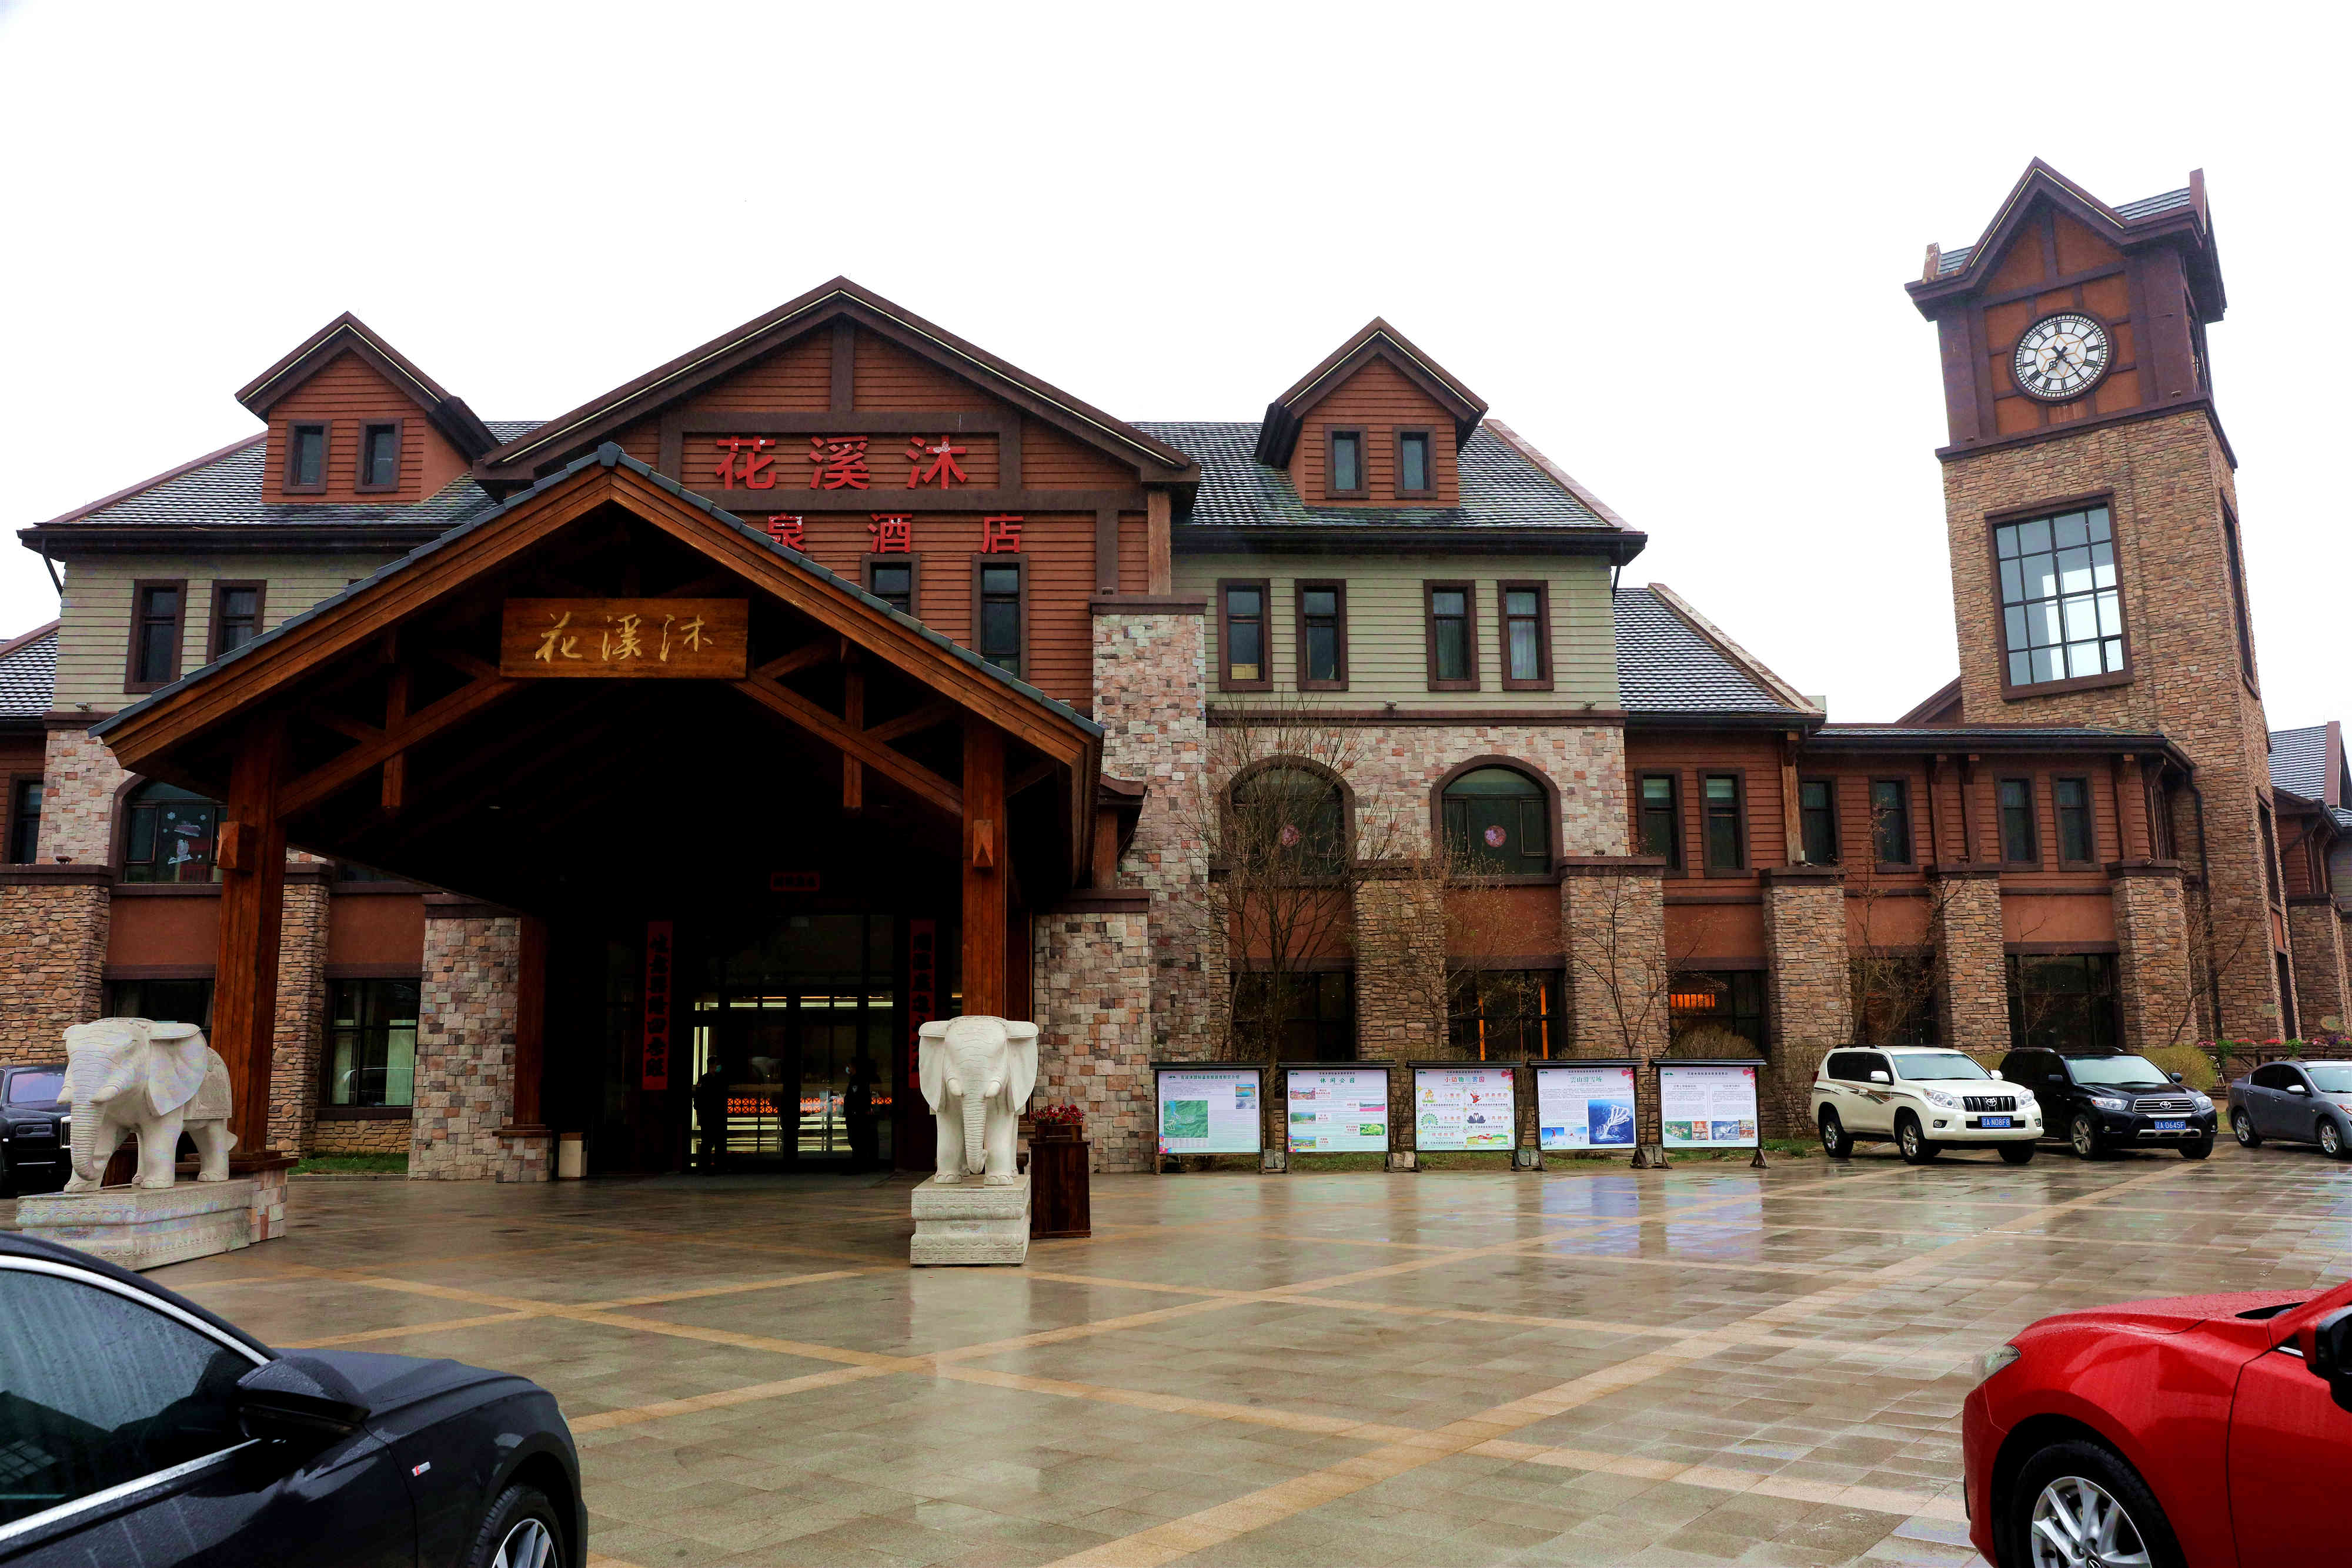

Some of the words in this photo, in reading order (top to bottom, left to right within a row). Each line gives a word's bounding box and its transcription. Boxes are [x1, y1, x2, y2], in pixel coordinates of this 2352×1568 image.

[715, 435, 967, 490] 花溪沐
[535, 611, 713, 663] 花溪沐
